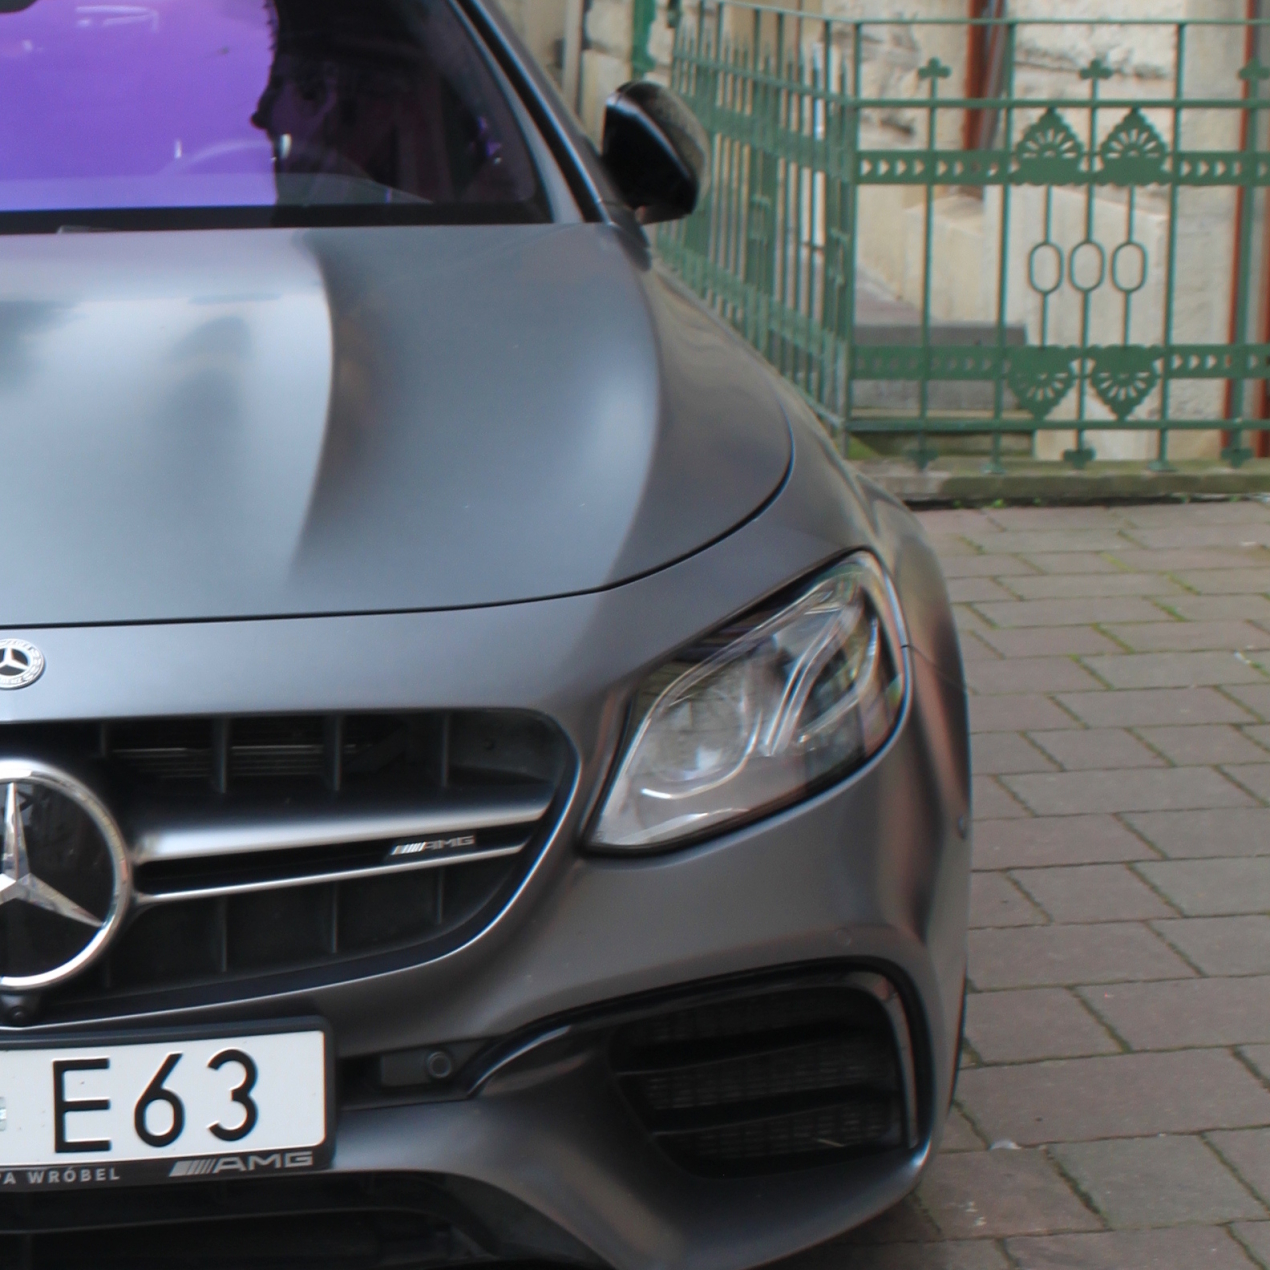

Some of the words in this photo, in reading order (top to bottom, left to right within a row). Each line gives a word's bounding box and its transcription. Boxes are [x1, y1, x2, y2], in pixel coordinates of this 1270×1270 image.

[52, 1048, 260, 1154] E63
[212, 1151, 314, 1174] AMG
[28, 1165, 120, 1185] WRÓBEL
